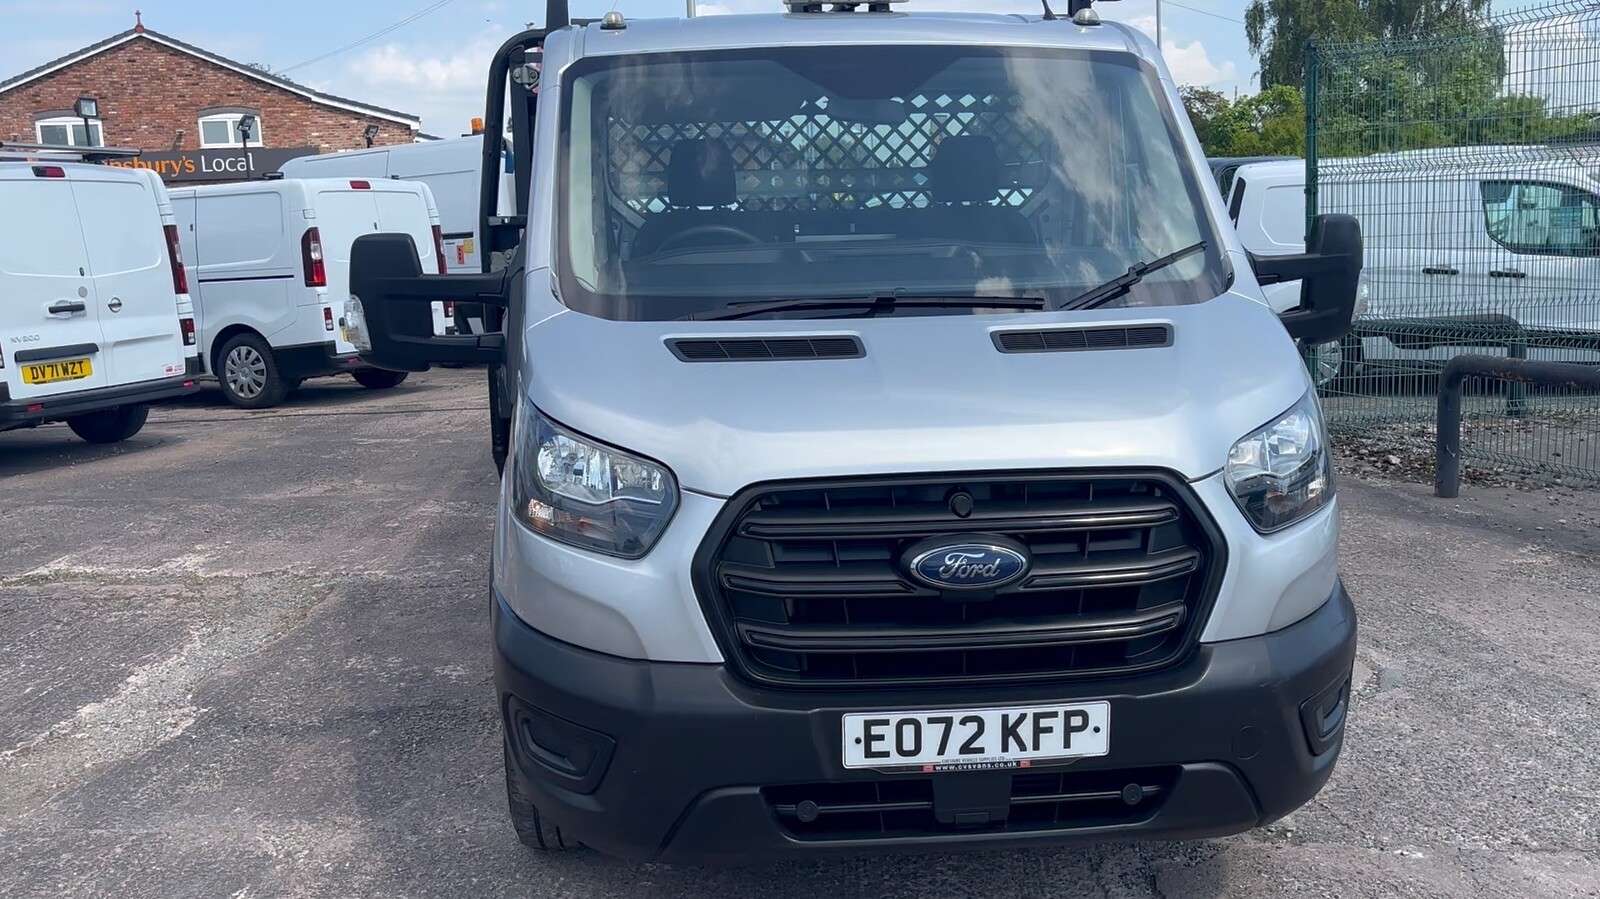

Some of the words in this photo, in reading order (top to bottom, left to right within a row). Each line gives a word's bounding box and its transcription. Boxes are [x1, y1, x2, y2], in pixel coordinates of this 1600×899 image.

[201, 152, 255, 173] Local
[30, 363, 60, 380] DV71
[60, 360, 84, 377] WZT
[939, 552, 1001, 579] Ford
[863, 714, 986, 759] EO72
[1000, 709, 1090, 753] KFP
[935, 761, 1017, 770] www.cvsvans.co.uk
